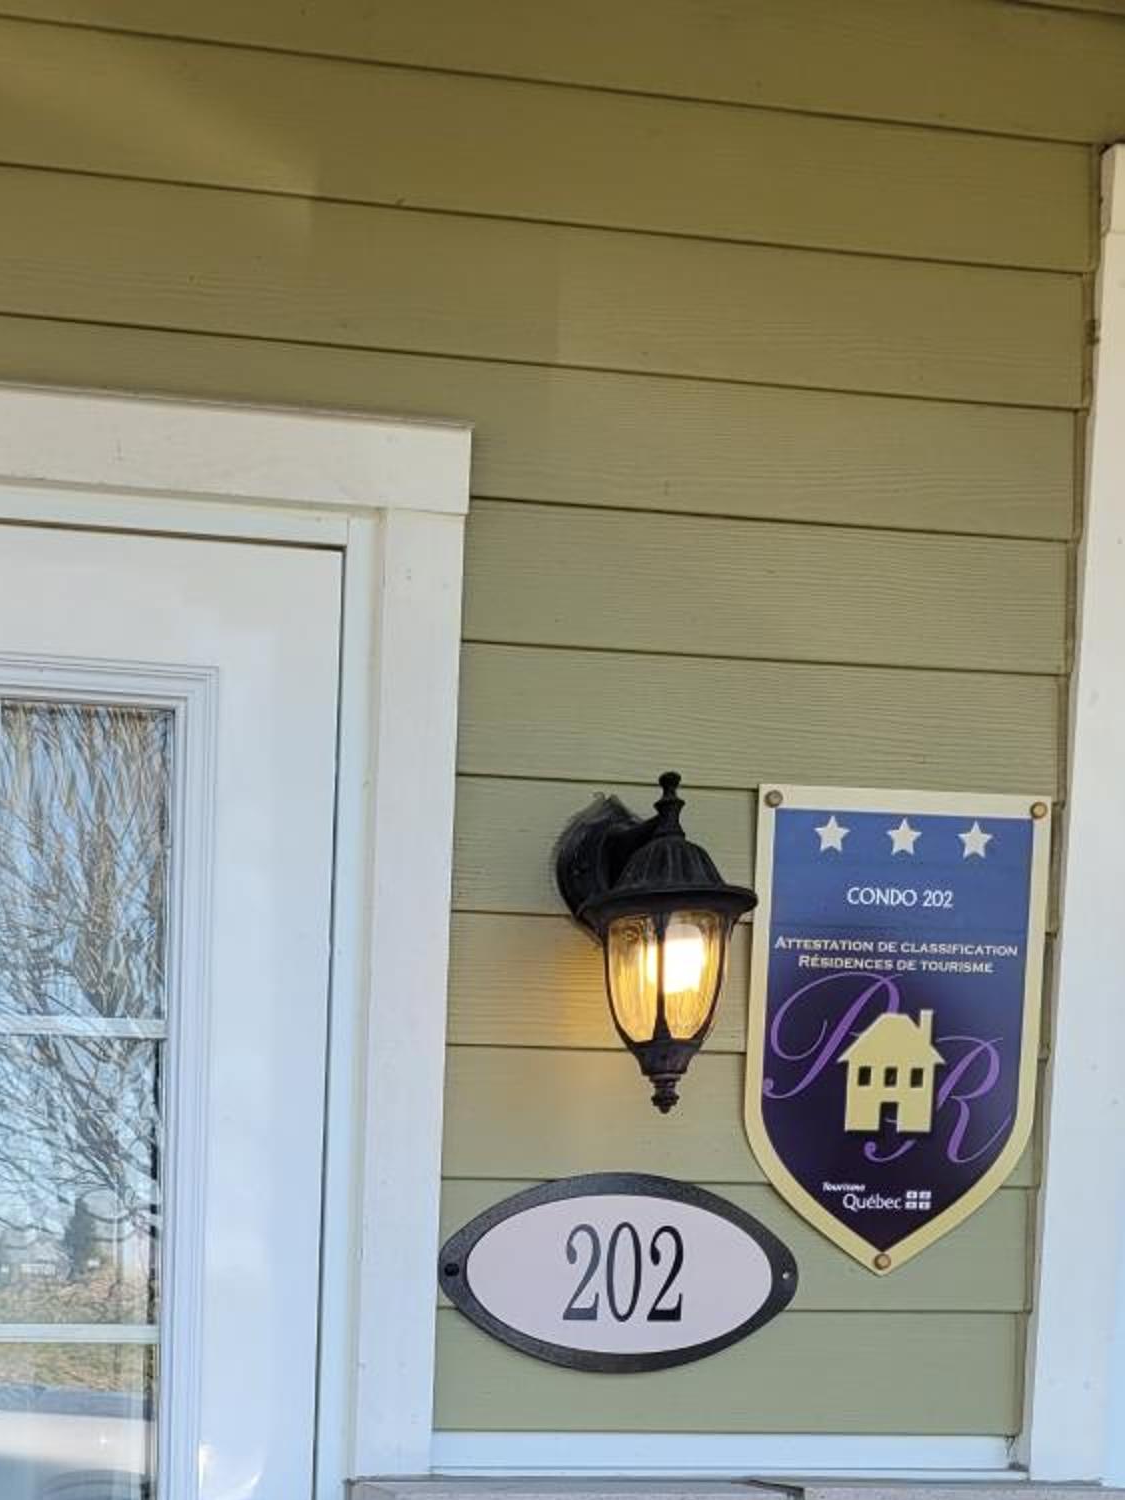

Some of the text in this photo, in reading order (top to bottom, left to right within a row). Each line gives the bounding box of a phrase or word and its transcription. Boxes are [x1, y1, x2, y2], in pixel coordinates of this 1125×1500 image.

[846, 887, 954, 908] CONDO 202
[877, 941, 897, 953] DE
[900, 943, 1018, 957] CLASSIFICATION
[897, 959, 917, 971] DE
[921, 960, 994, 973] TOURISME
[842, 1193, 903, 1212] Québec
[562, 1221, 684, 1322] 202
